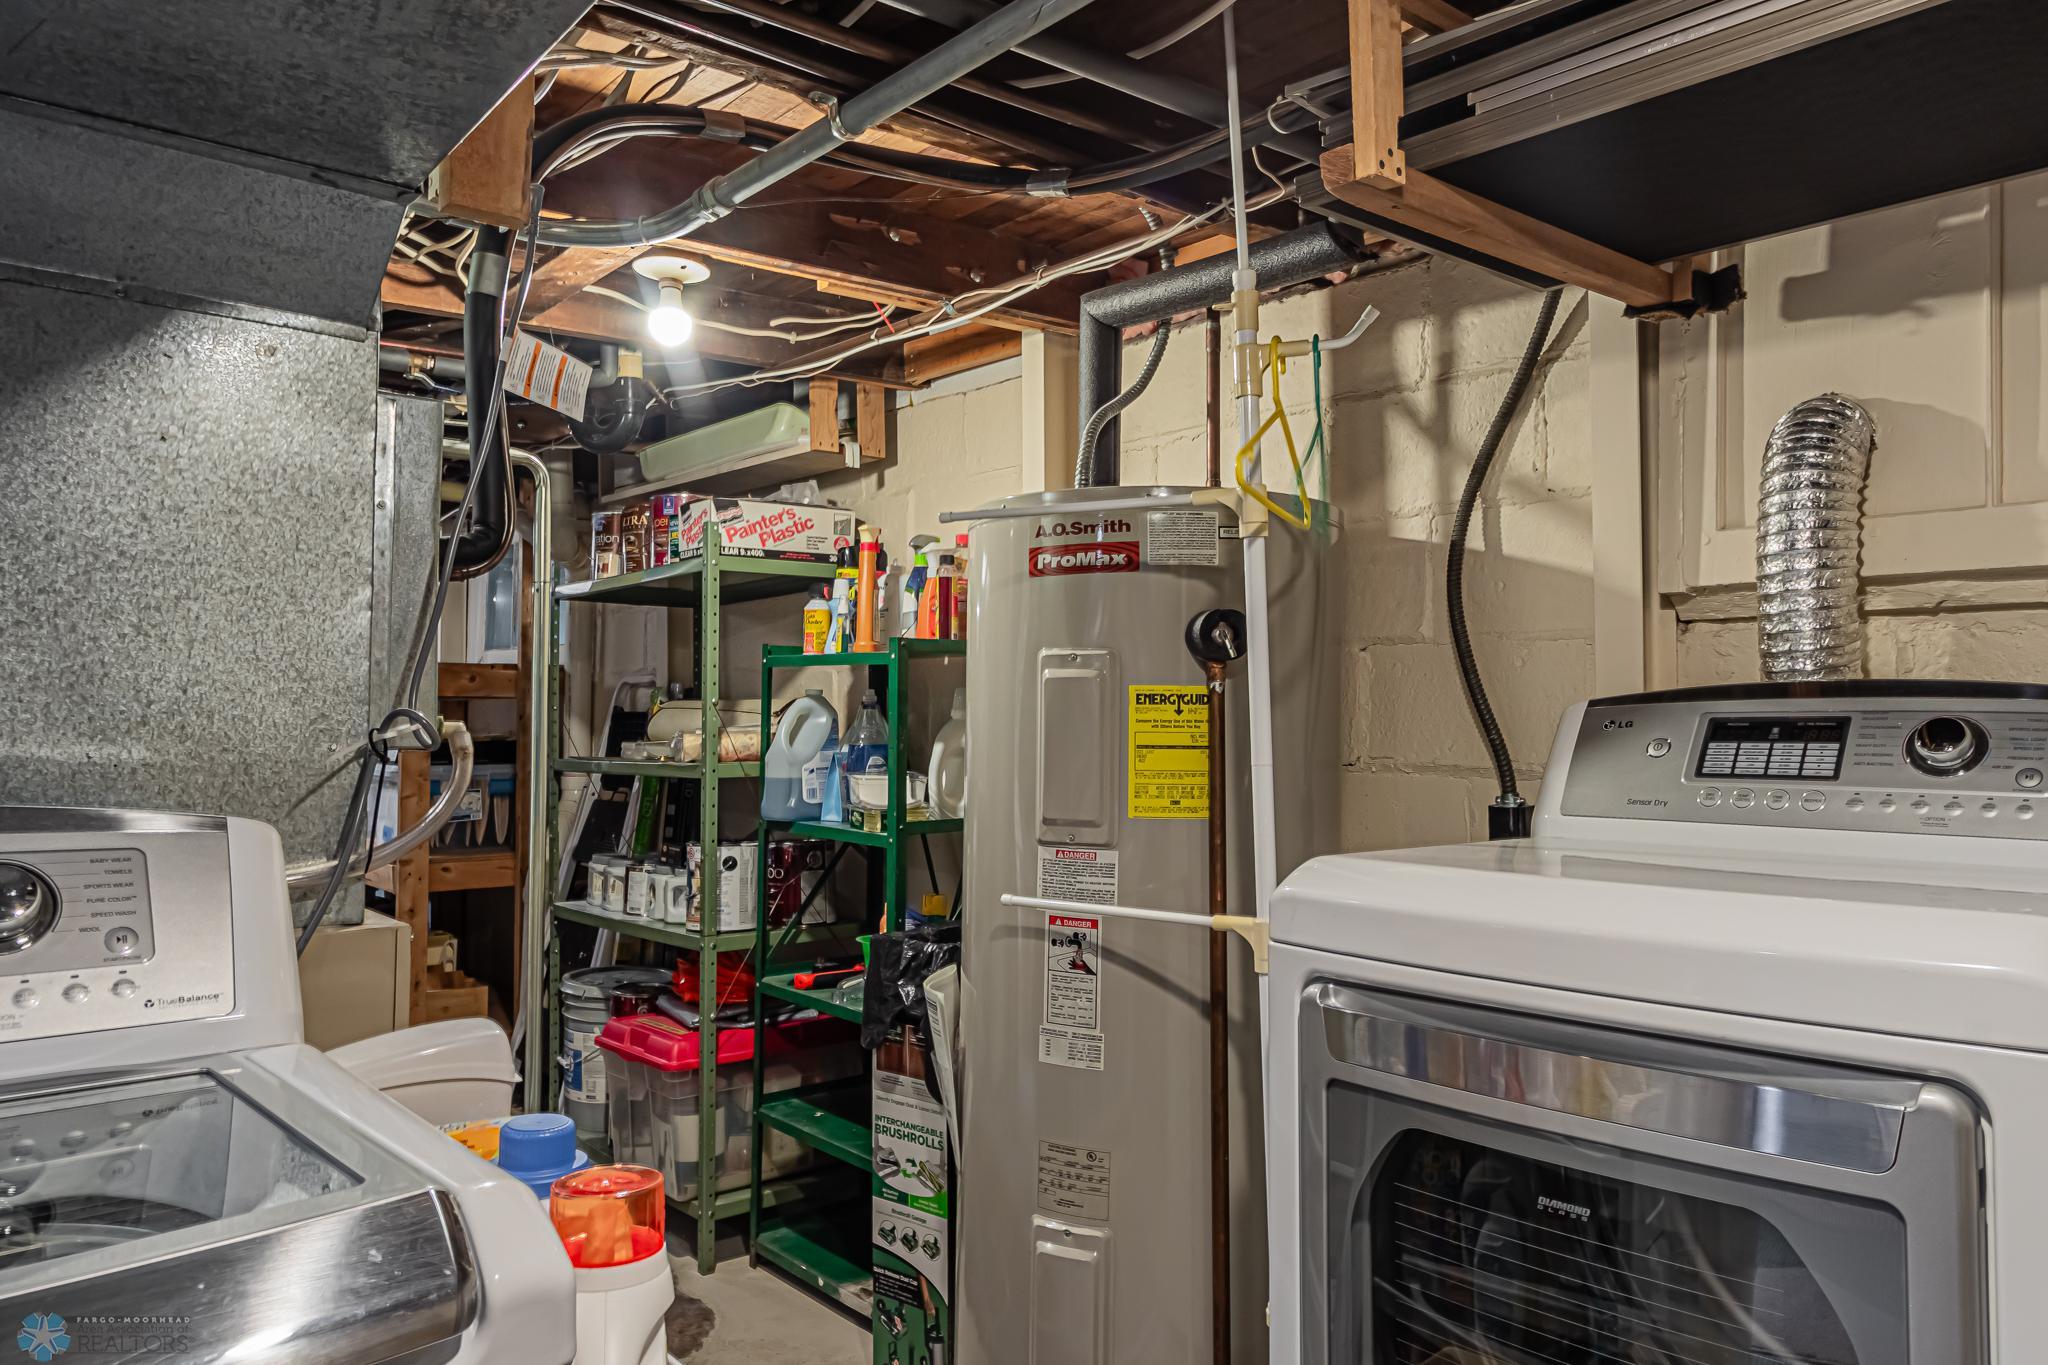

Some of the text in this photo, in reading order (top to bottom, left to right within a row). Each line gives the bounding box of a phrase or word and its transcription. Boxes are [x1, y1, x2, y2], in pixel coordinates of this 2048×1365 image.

[725, 507, 797, 543] Painter's
[758, 516, 815, 548] Plastic
[721, 546, 739, 556] LEAR
[1037, 552, 1127, 570] ProMax
[1136, 693, 1209, 705] ENERGYGUID
[1627, 798, 1669, 807] Sensor Dry
[1064, 851, 1096, 860] DANGER
[1063, 920, 1092, 928] DANGER
[874, 1113, 944, 1139] INTERCHANGEABLE
[874, 1123, 944, 1151] BRUSHROLLS
[1538, 1196, 1591, 1217] DIAMOND
